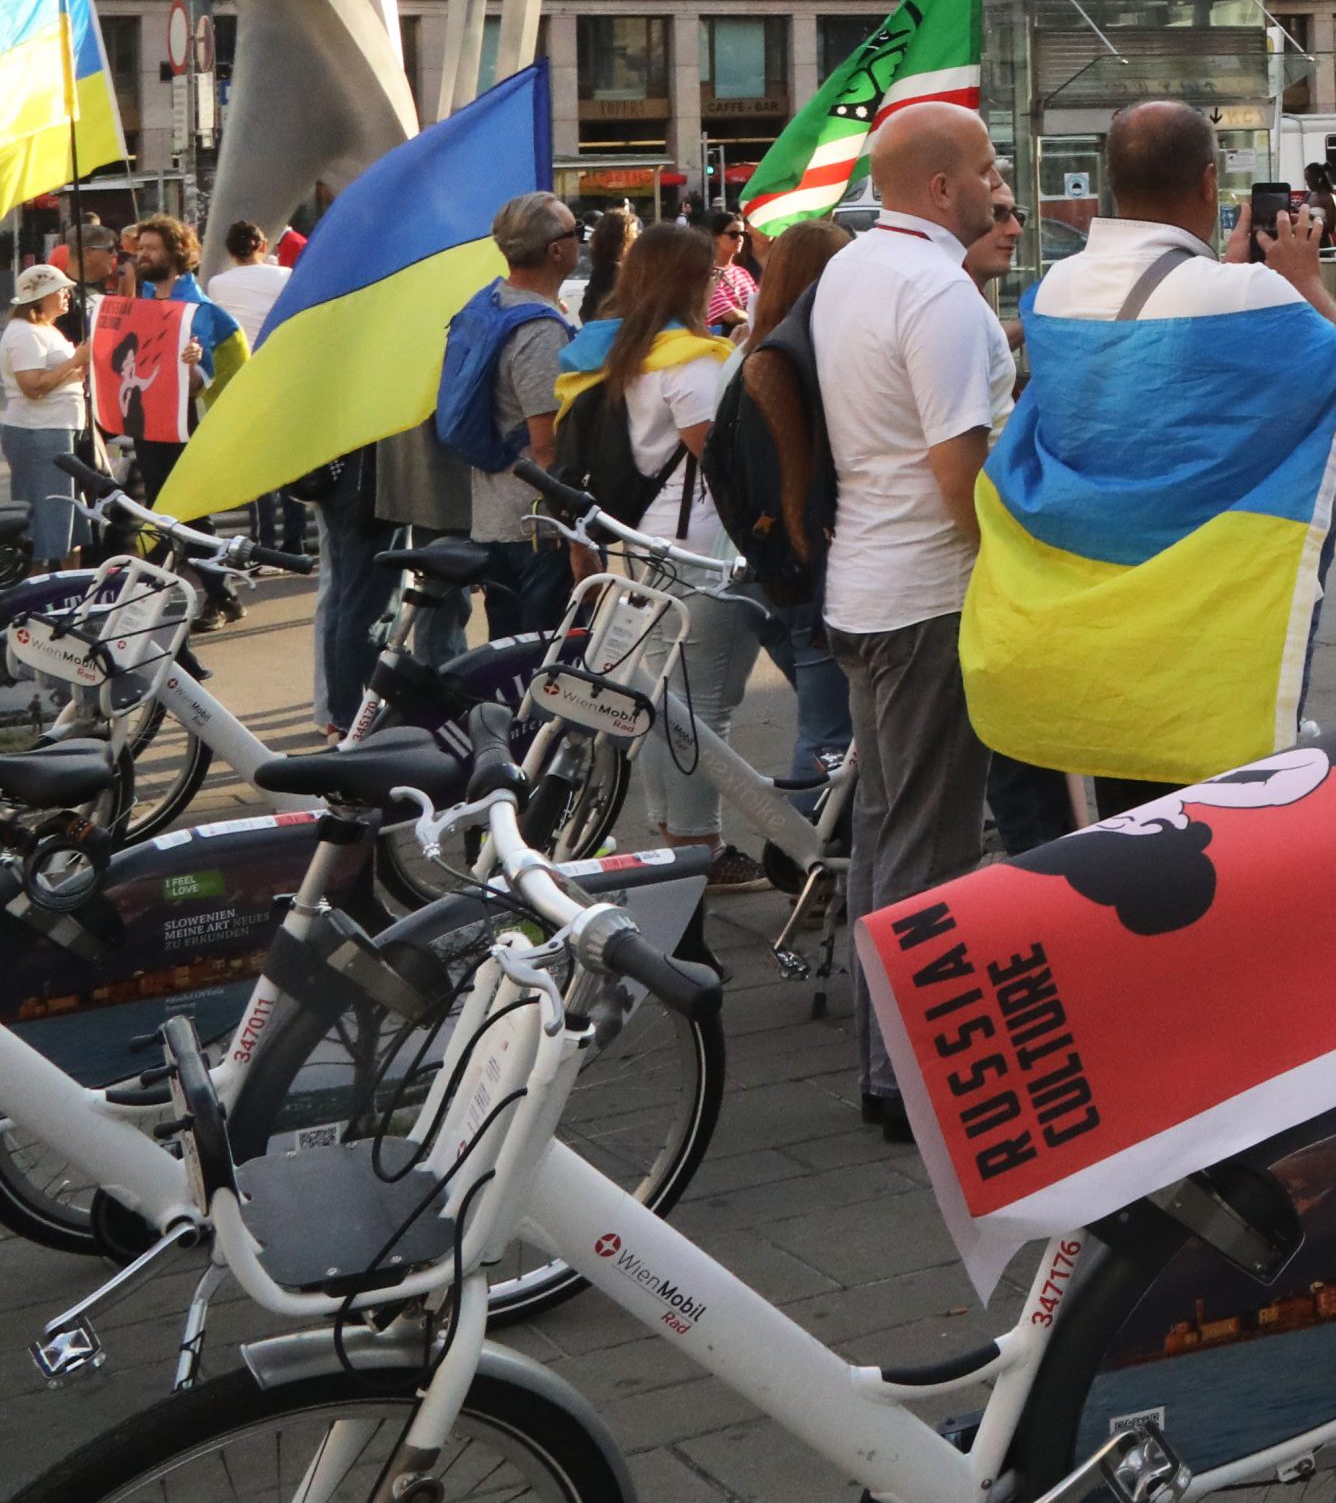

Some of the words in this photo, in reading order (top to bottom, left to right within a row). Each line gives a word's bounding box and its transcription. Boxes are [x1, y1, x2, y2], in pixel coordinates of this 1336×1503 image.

[757, 101, 779, 112] BAR
[31, 639, 97, 671] WienMobil
[353, 701, 378, 741] 345170
[563, 688, 638, 724] WienMobil
[613, 719, 635, 734] Rad
[172, 875, 197, 888] FEEL
[165, 926, 205, 941] MEINE
[206, 919, 231, 933] ART
[234, 998, 275, 1064] 347011
[891, 901, 1038, 1182] RUSSIAN
[986, 942, 1101, 1149] CULTURE
[617, 1249, 706, 1322] WienMobil
[1031, 1240, 1081, 1329] 347176
[661, 1311, 692, 1335] Rad
